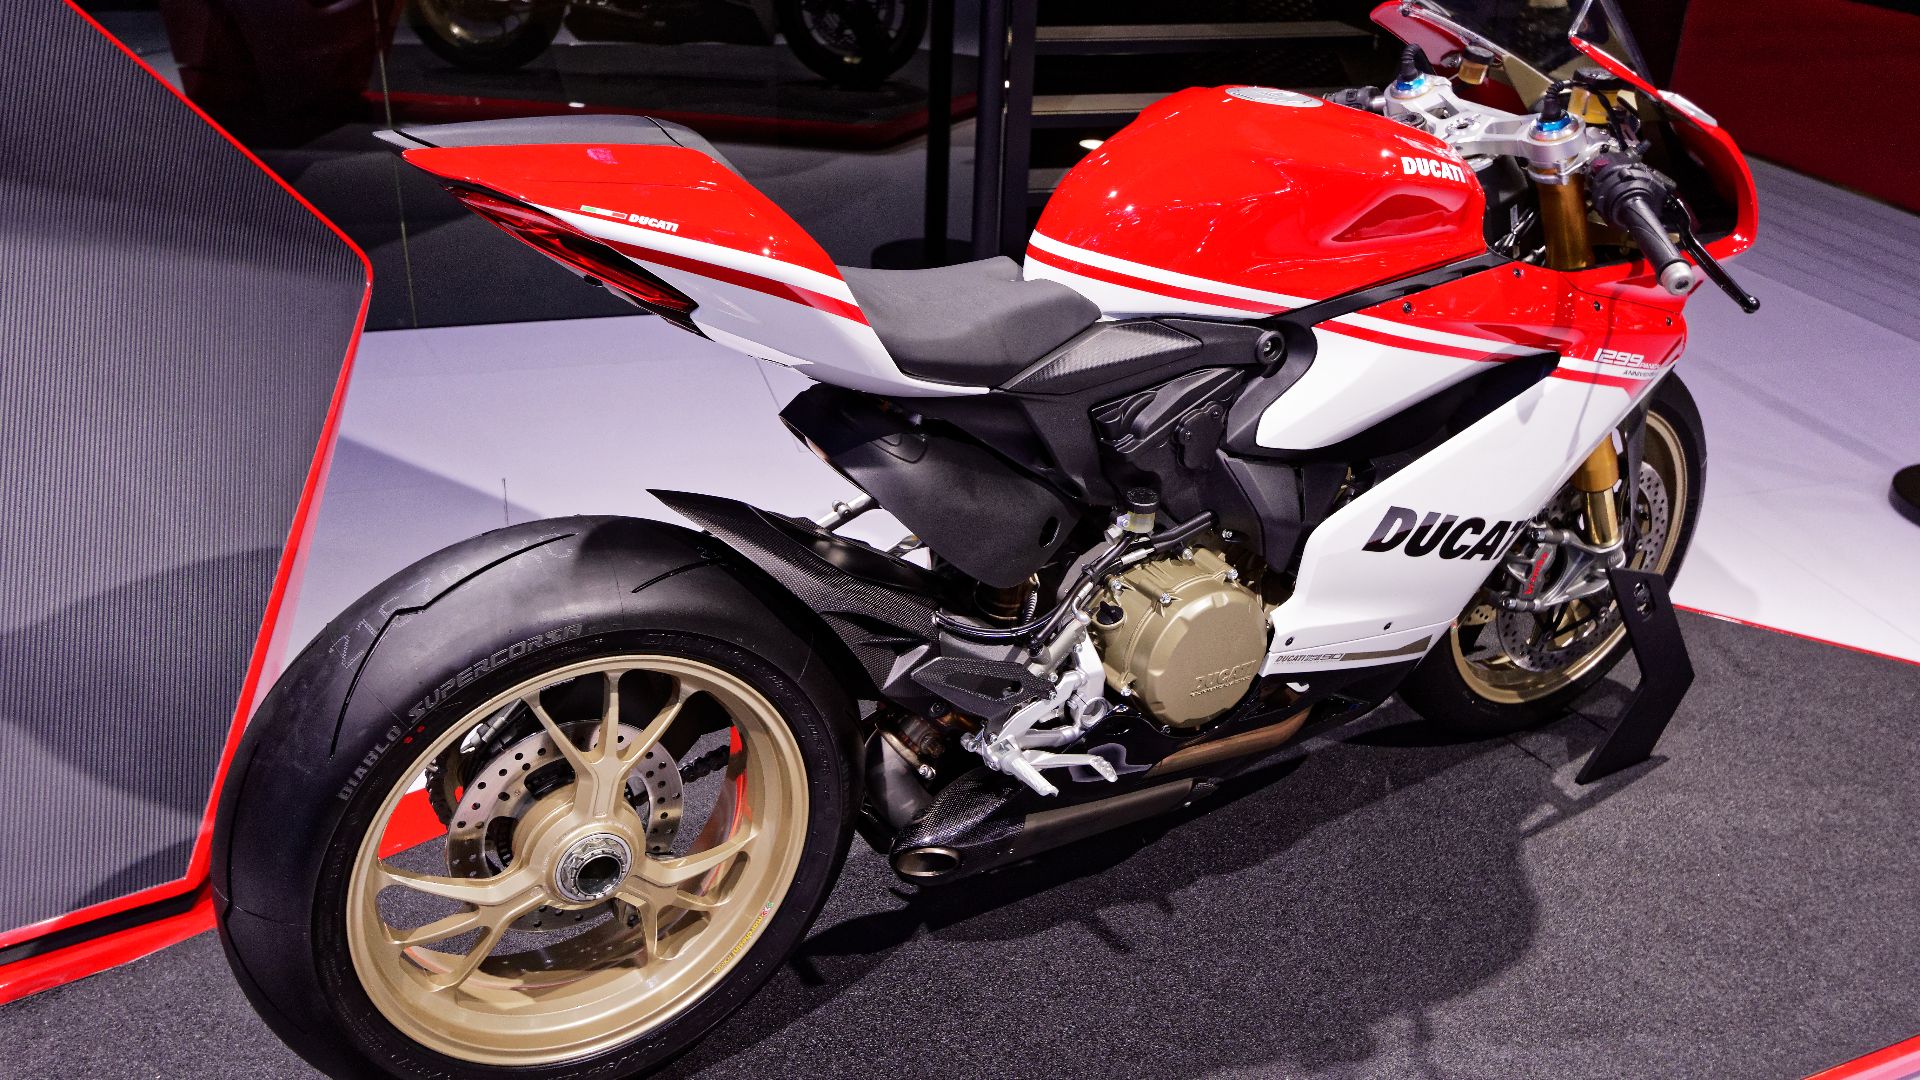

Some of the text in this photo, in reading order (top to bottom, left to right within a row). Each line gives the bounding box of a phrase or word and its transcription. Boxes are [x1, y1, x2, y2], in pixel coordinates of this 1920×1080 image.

[1401, 156, 1466, 183] DUCATI
[628, 213, 679, 233] DUCATI
[1593, 347, 1645, 368] 1299
[1361, 505, 1529, 561] DUCAT
[336, 724, 402, 801] DIABLO
